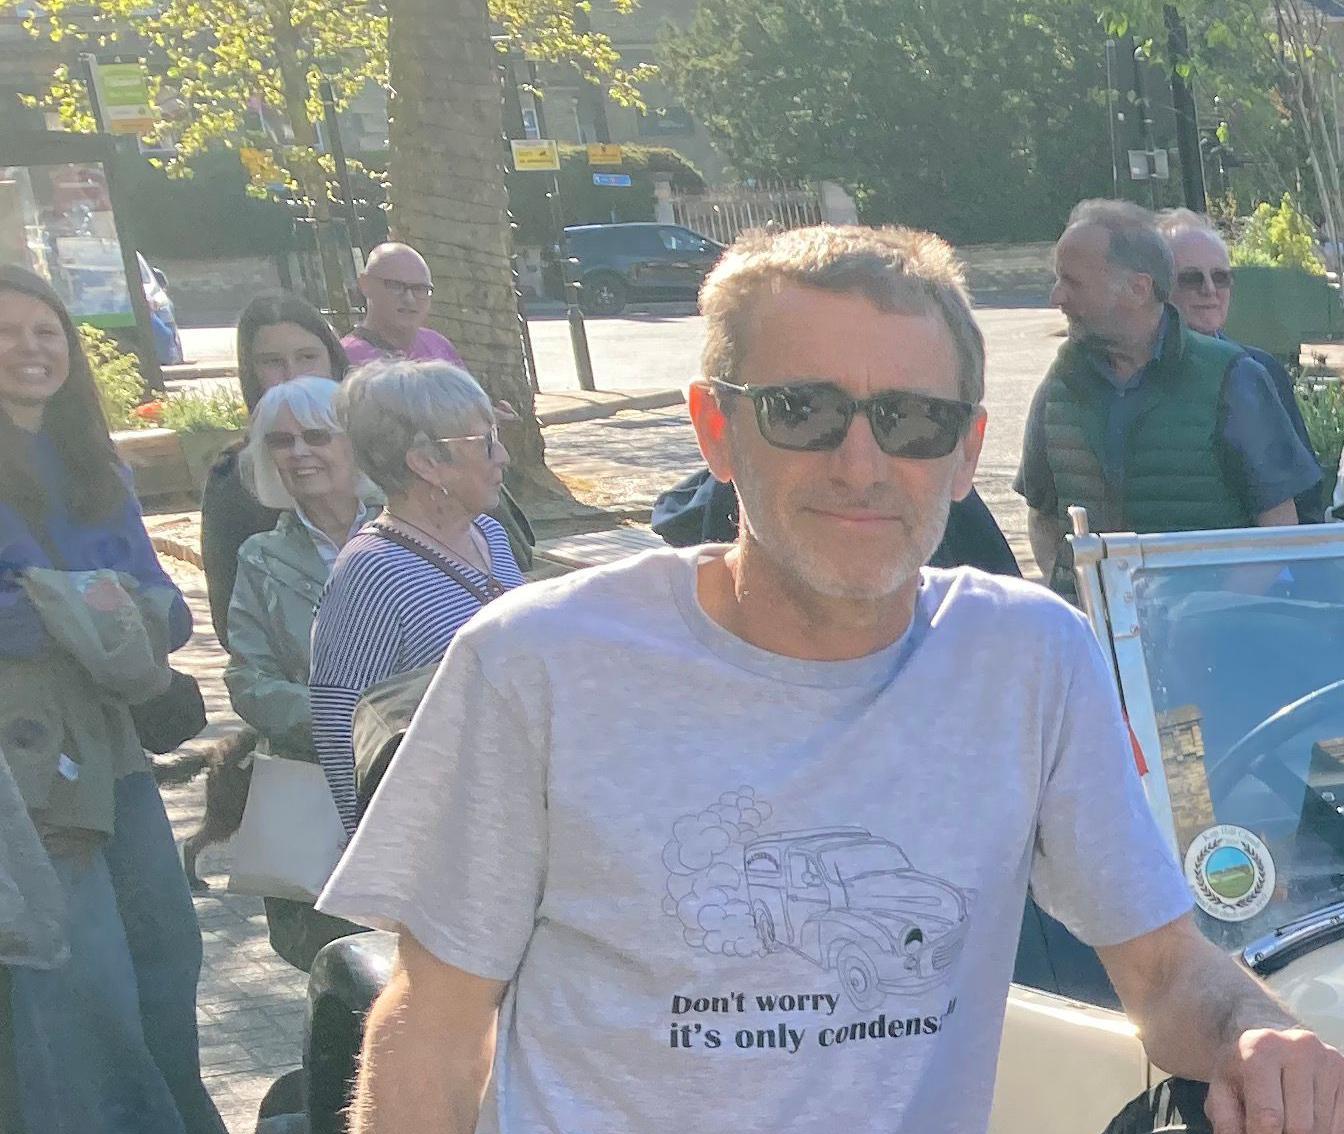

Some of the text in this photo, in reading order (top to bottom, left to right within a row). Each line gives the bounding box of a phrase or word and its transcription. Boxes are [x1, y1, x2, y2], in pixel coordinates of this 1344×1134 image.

[671, 991, 840, 1016] Don't worry
[670, 1013, 944, 1054] it's only condens
